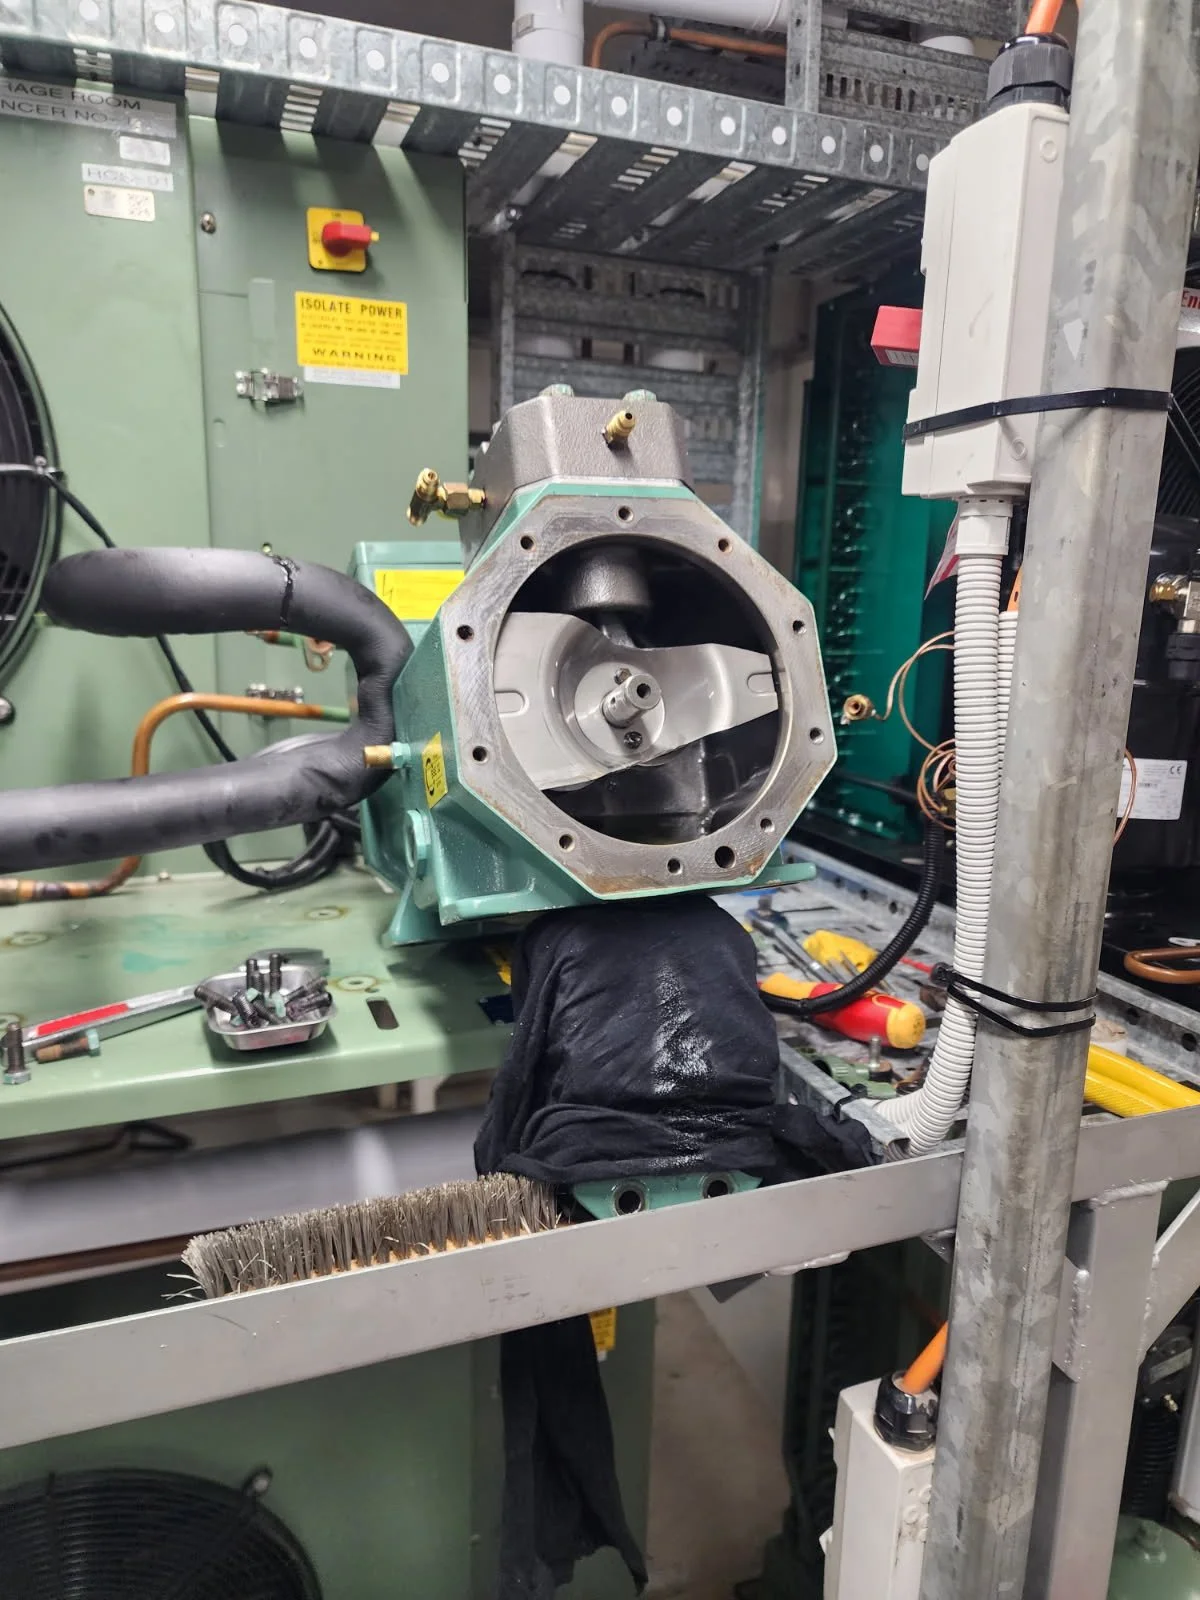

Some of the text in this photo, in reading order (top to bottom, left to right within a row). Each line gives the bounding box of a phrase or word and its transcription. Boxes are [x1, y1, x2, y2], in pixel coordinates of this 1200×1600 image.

[72, 91, 141, 110] ROOM
[301, 298, 402, 319] ISOLATE POWER
[312, 347, 396, 363] WARNING
